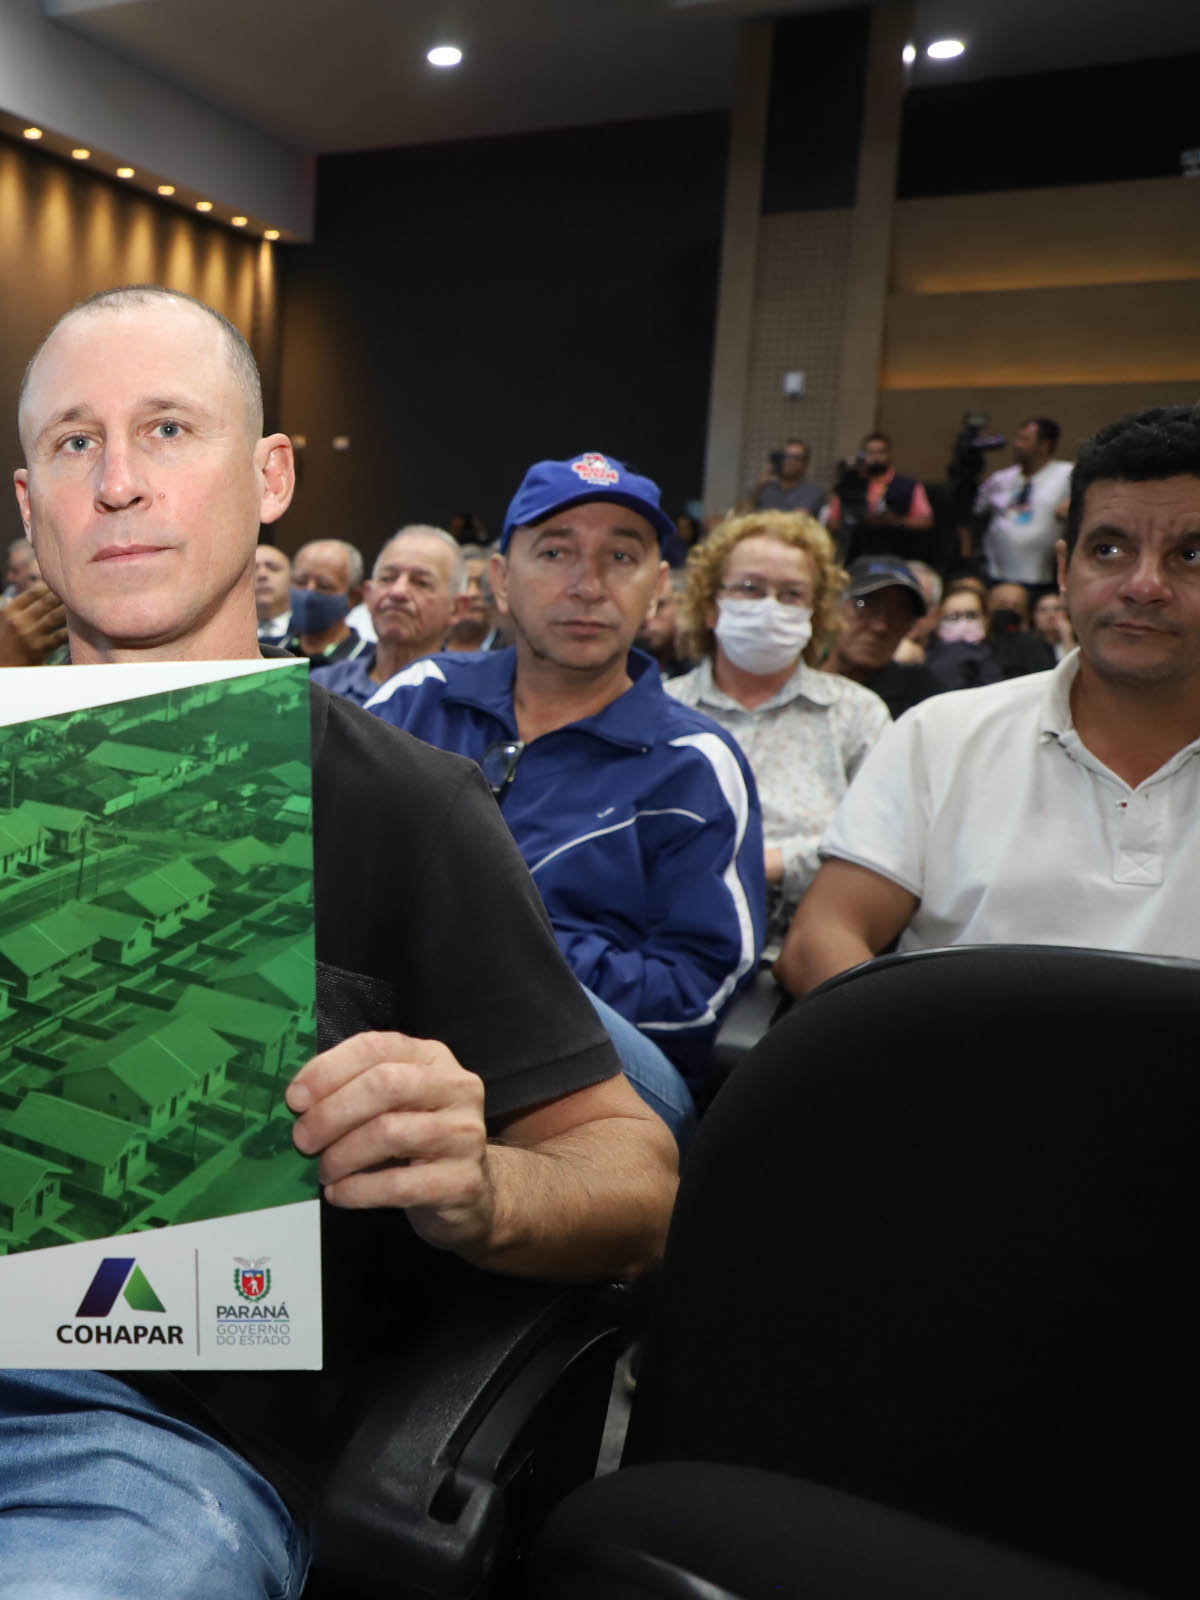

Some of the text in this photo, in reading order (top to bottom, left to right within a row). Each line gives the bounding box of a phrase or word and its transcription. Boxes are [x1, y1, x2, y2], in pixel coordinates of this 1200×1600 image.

[216, 1302, 289, 1319] PARANÁ
[56, 1325, 184, 1345] COHAPAR
[216, 1324, 290, 1335] GOVERNO
[216, 1335, 291, 1346] DO ESTADO
